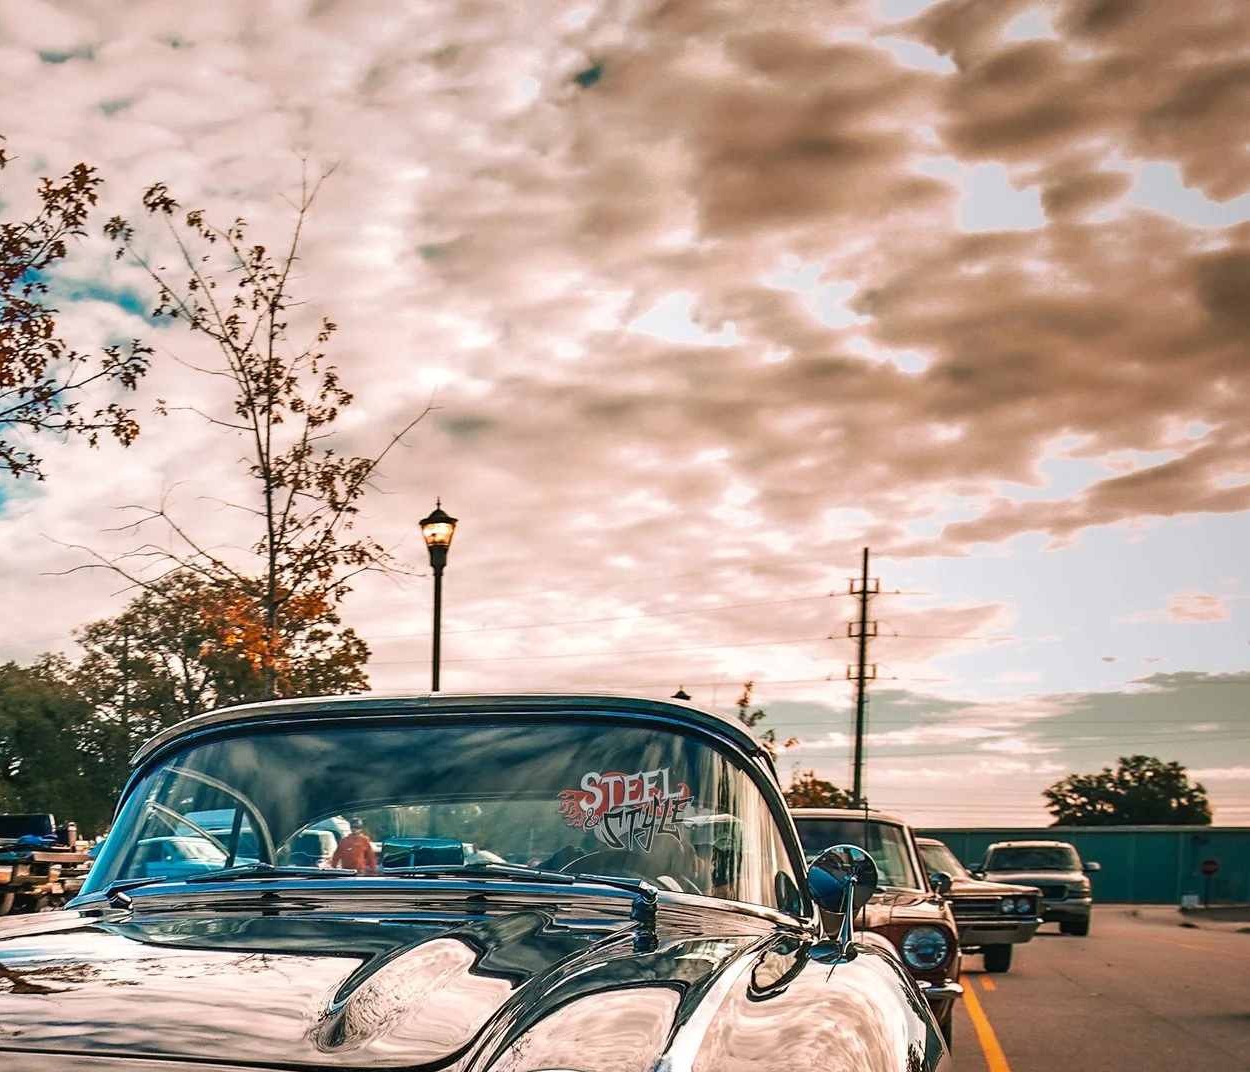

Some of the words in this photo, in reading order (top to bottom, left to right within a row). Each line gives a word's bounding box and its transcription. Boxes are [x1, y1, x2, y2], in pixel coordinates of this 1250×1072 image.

[579, 767, 685, 812] STEEL
[584, 807, 600, 829] &
[601, 796, 695, 853] STYLE
